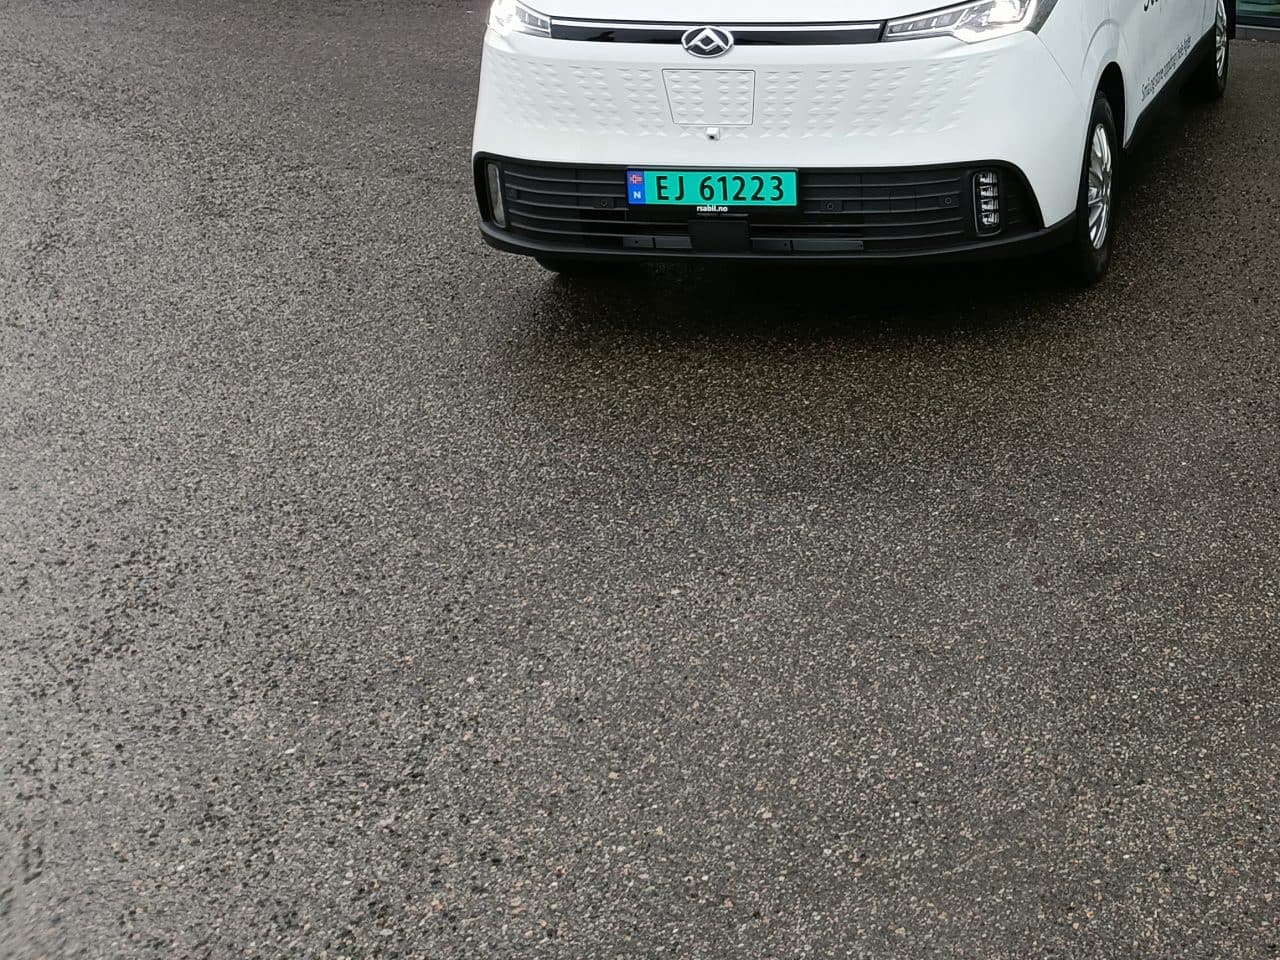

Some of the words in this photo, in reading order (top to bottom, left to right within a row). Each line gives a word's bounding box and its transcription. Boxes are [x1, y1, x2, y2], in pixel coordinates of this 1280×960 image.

[633, 191, 641, 199] N
[656, 175, 685, 201] EJ
[699, 175, 785, 202] 61223
